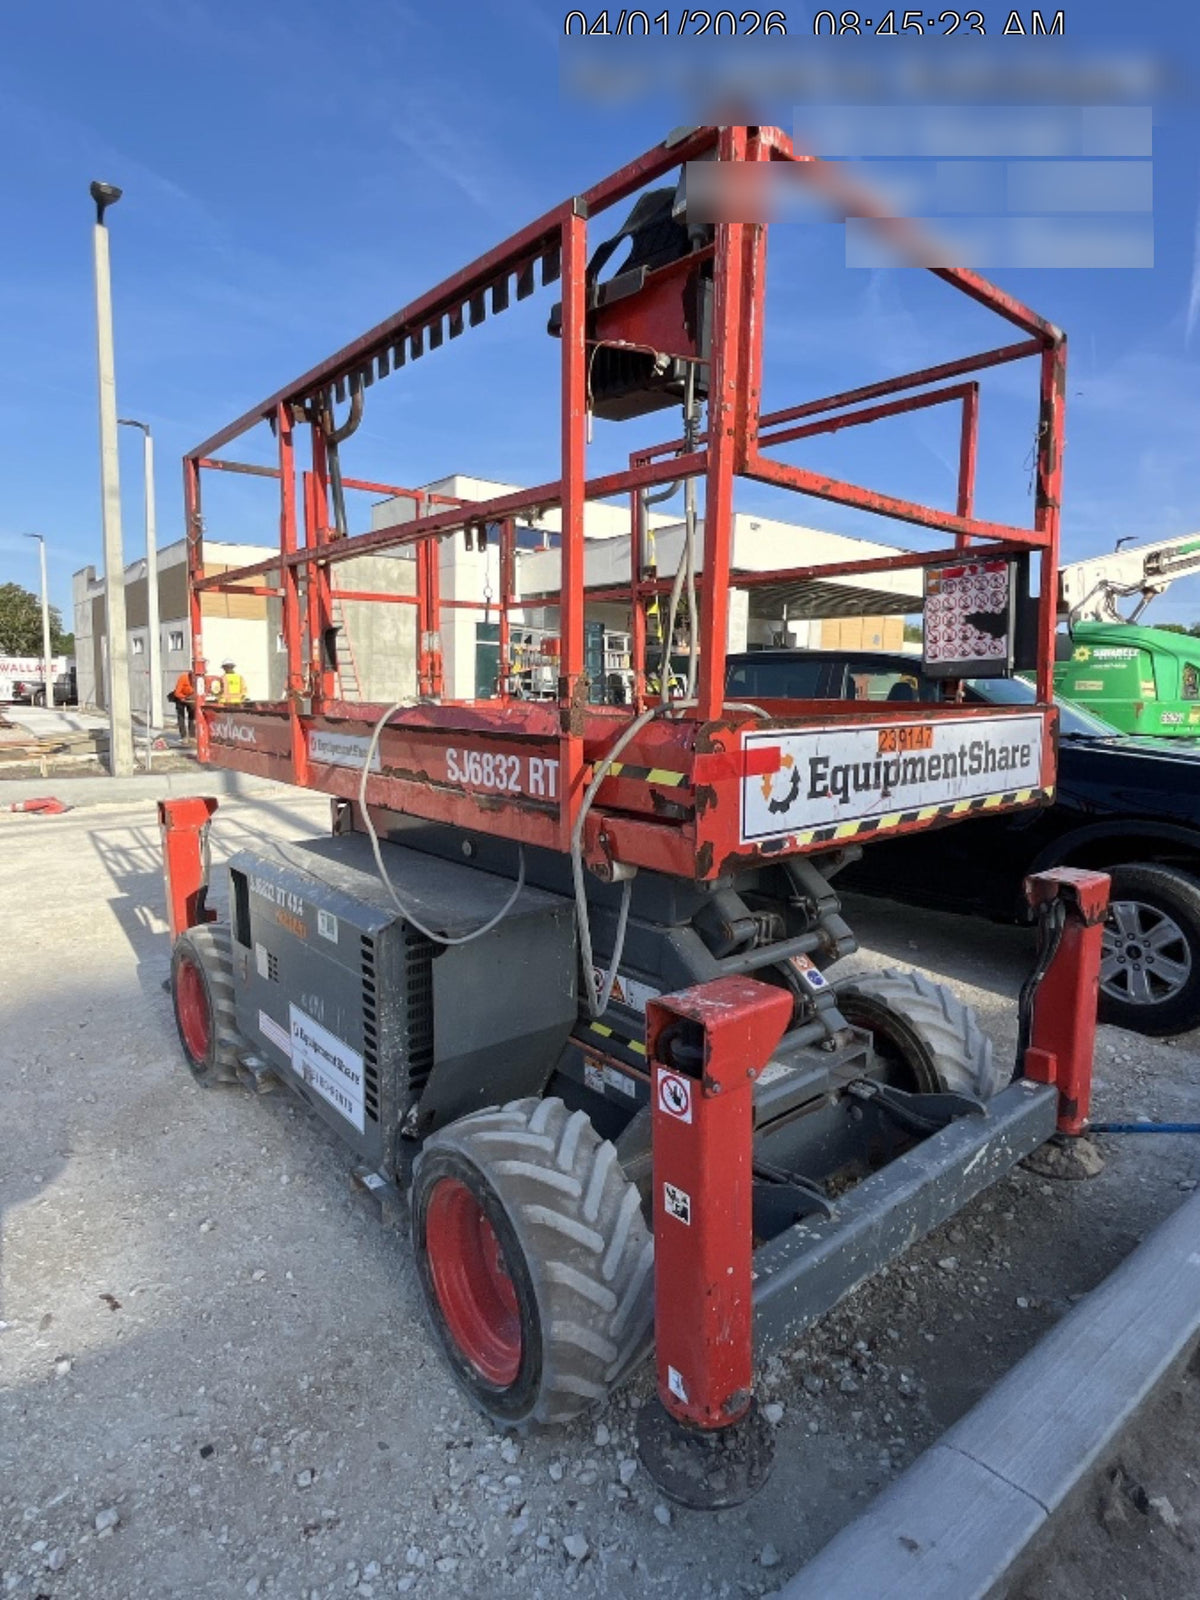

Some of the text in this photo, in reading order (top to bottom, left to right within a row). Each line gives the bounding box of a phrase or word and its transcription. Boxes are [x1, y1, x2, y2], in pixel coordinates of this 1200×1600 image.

[446, 748, 559, 797] SJ6832 RT
[807, 741, 1031, 804] EquipmentShare
